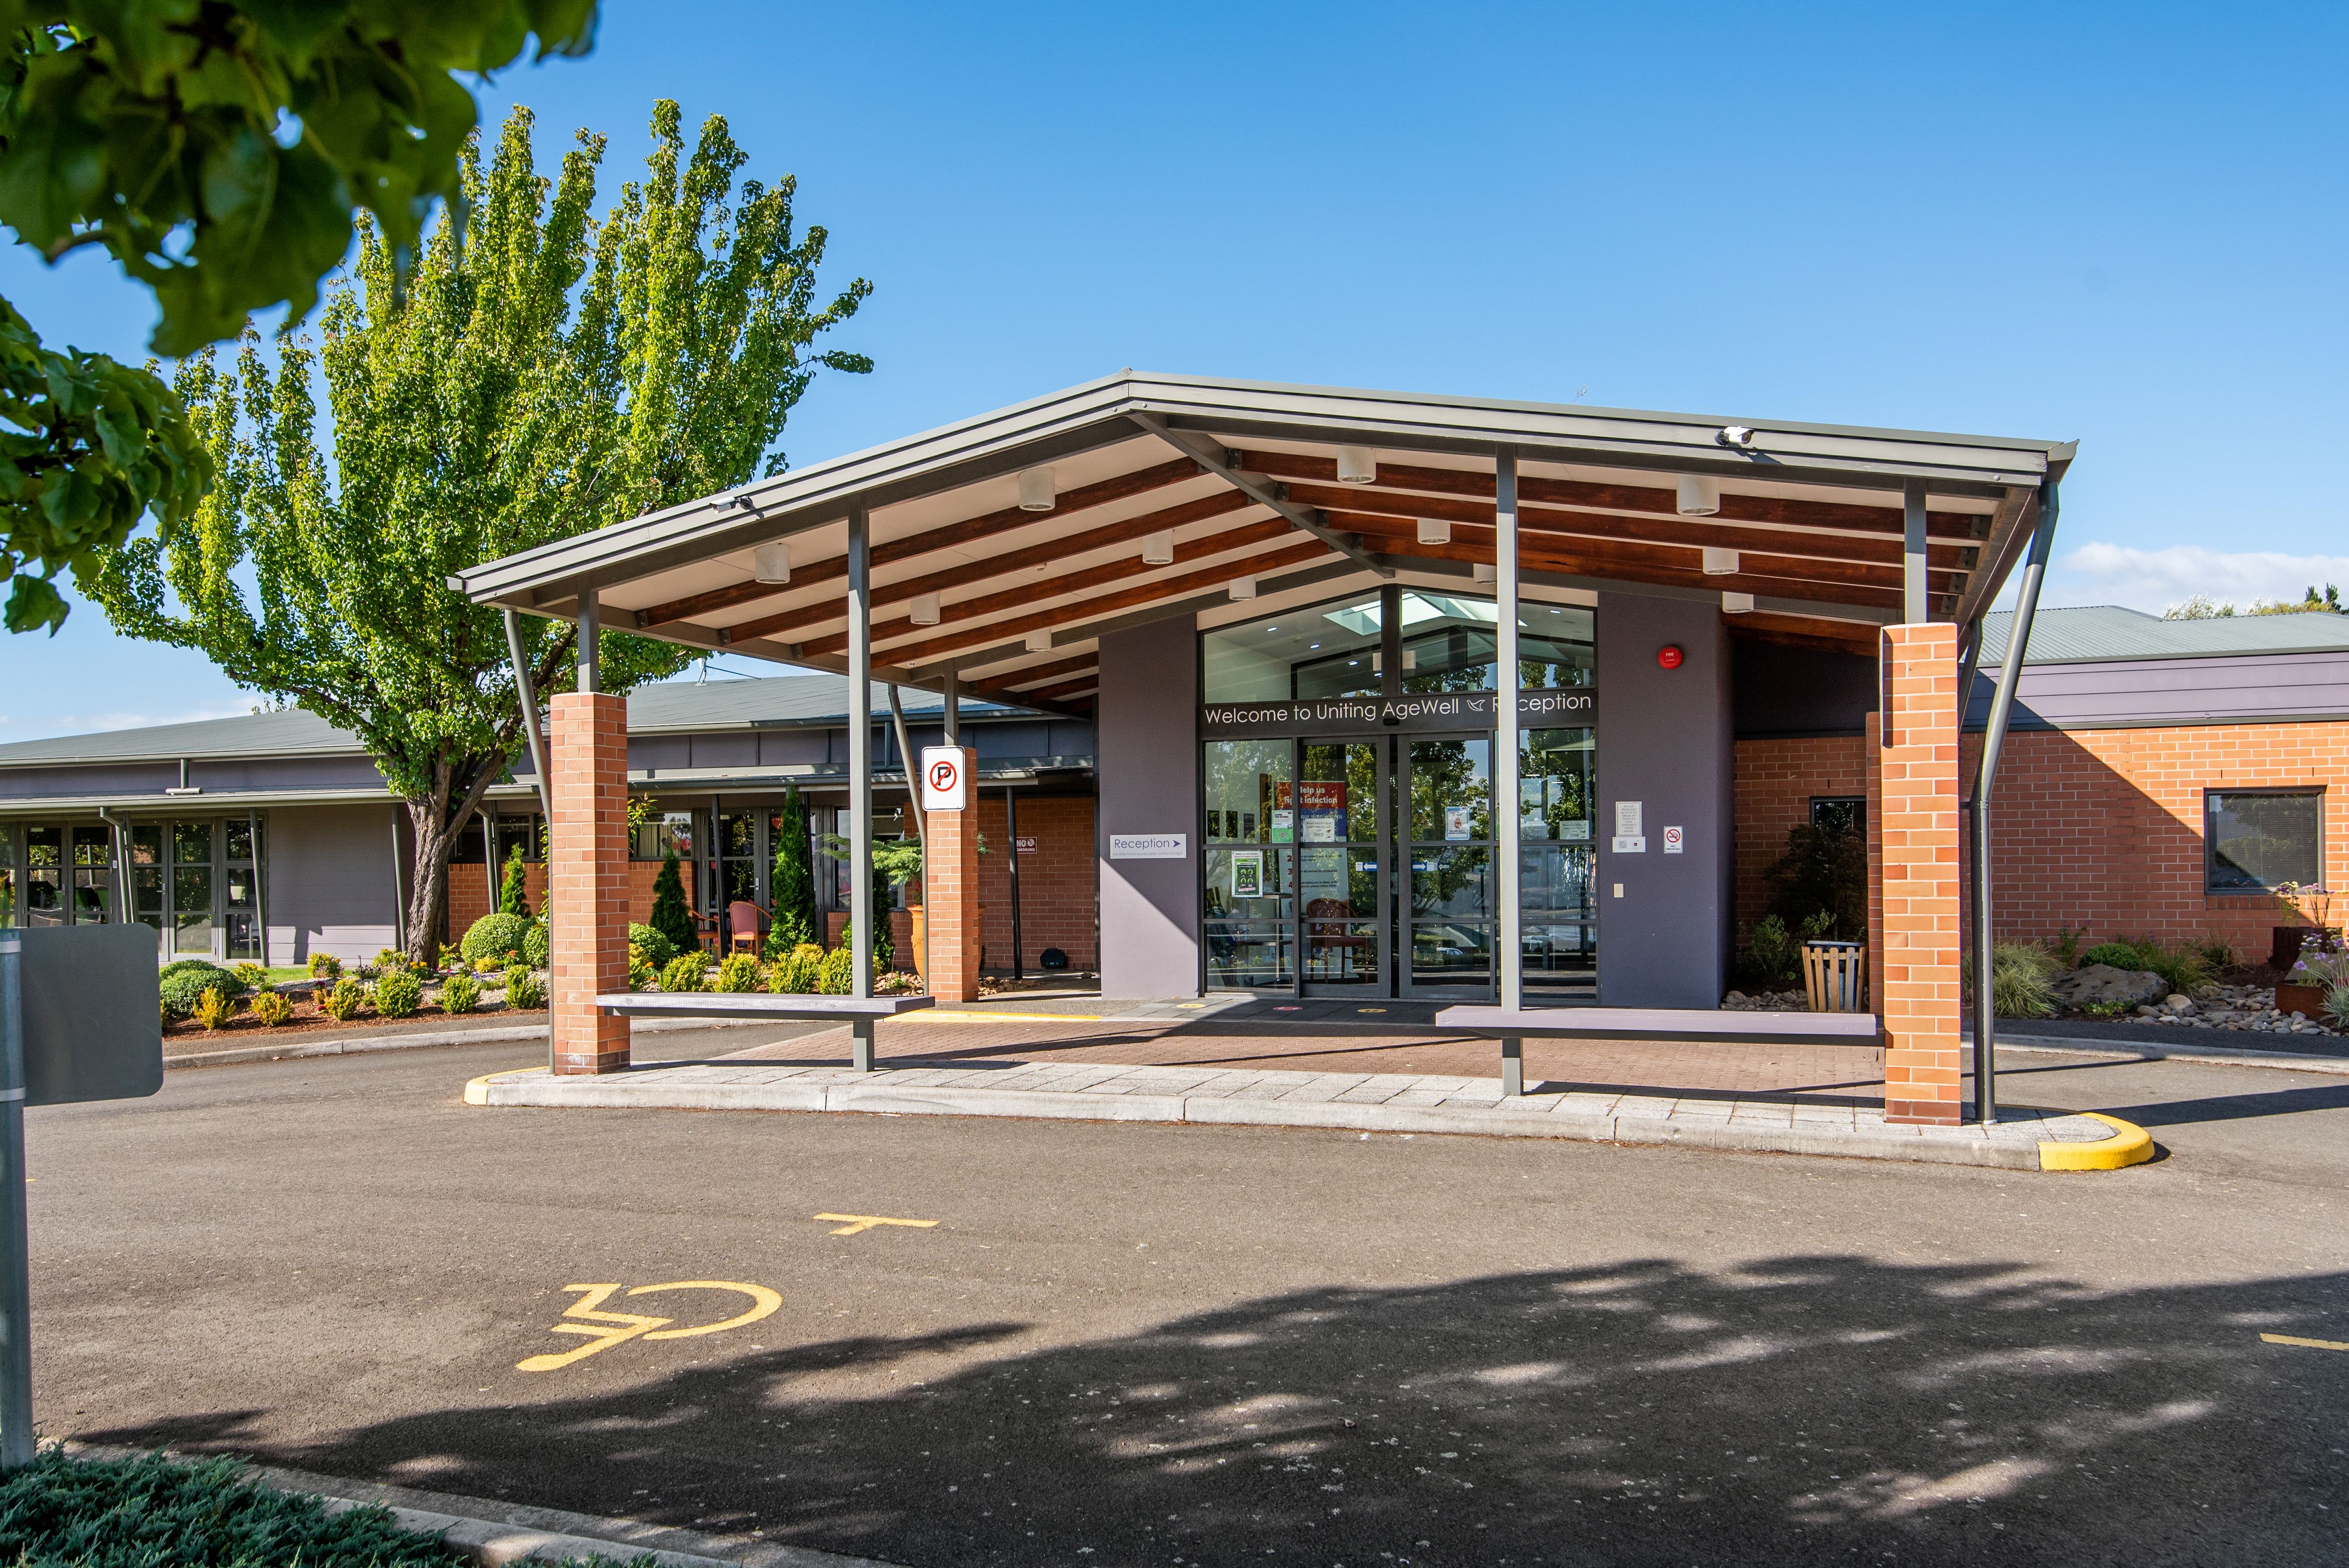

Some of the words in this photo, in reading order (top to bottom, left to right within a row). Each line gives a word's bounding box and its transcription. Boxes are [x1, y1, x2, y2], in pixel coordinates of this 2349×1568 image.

[1205, 708, 1287, 724] Welcome
[1293, 705, 1311, 721] to
[1317, 702, 1376, 721] Uniting
[1382, 698, 1458, 720] AgeWell
[1493, 694, 1591, 714] Rception
[1115, 838, 1170, 850] Reception
